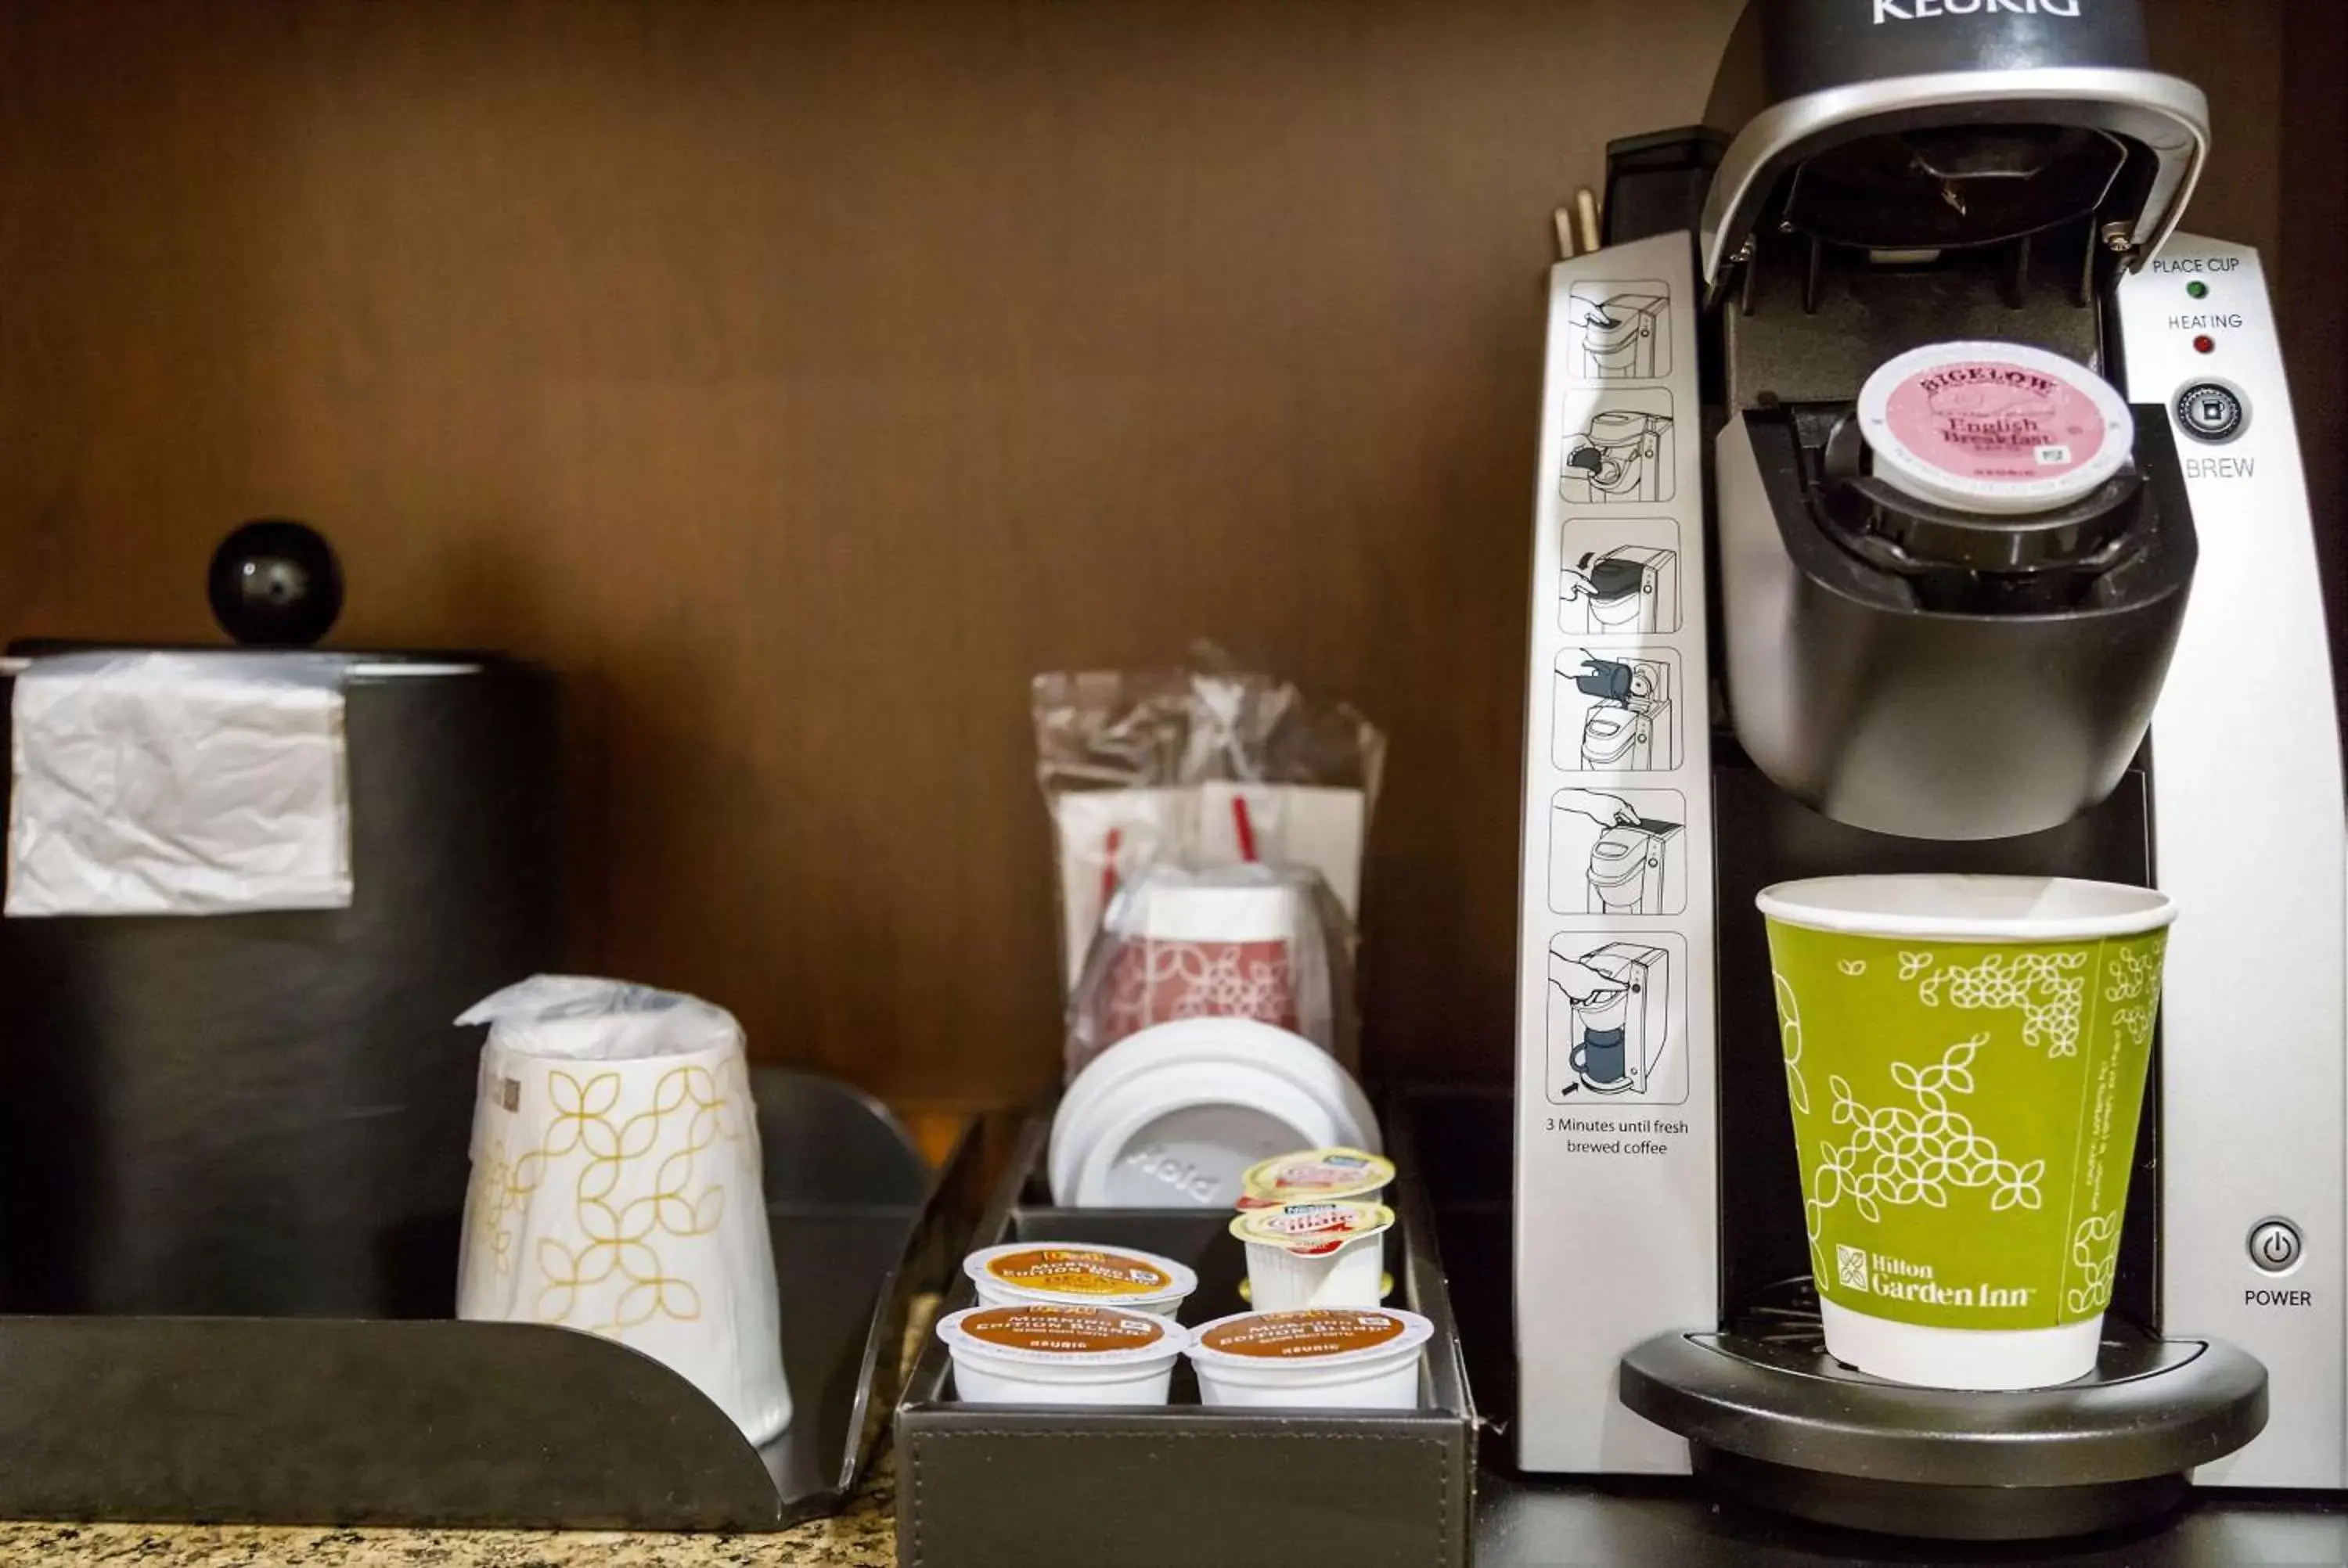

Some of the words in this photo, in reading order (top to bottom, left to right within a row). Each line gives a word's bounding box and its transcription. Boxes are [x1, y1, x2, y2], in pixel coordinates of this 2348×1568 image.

[2152, 259, 2202, 273] PLACE
[2207, 257, 2240, 272] CUP
[2168, 314, 2243, 329] HEATING
[1920, 367, 2058, 397] BIGELOW
[1947, 417, 2038, 434] English
[1942, 430, 2053, 445] Breakfast
[2186, 457, 2255, 479] BREW
[1545, 1117, 1554, 1131] 3
[1558, 1118, 1615, 1132] Minutes
[1619, 1120, 1651, 1133] until
[1654, 1120, 1689, 1134] fresh
[1567, 1139, 1620, 1154] brewed
[1624, 1141, 1668, 1155] coffee
[1871, 1252, 1934, 1278] Hilton
[1871, 1272, 1973, 1307] Garden
[1979, 1283, 2029, 1307] Inn
[2245, 1290, 2311, 1306] POWER
